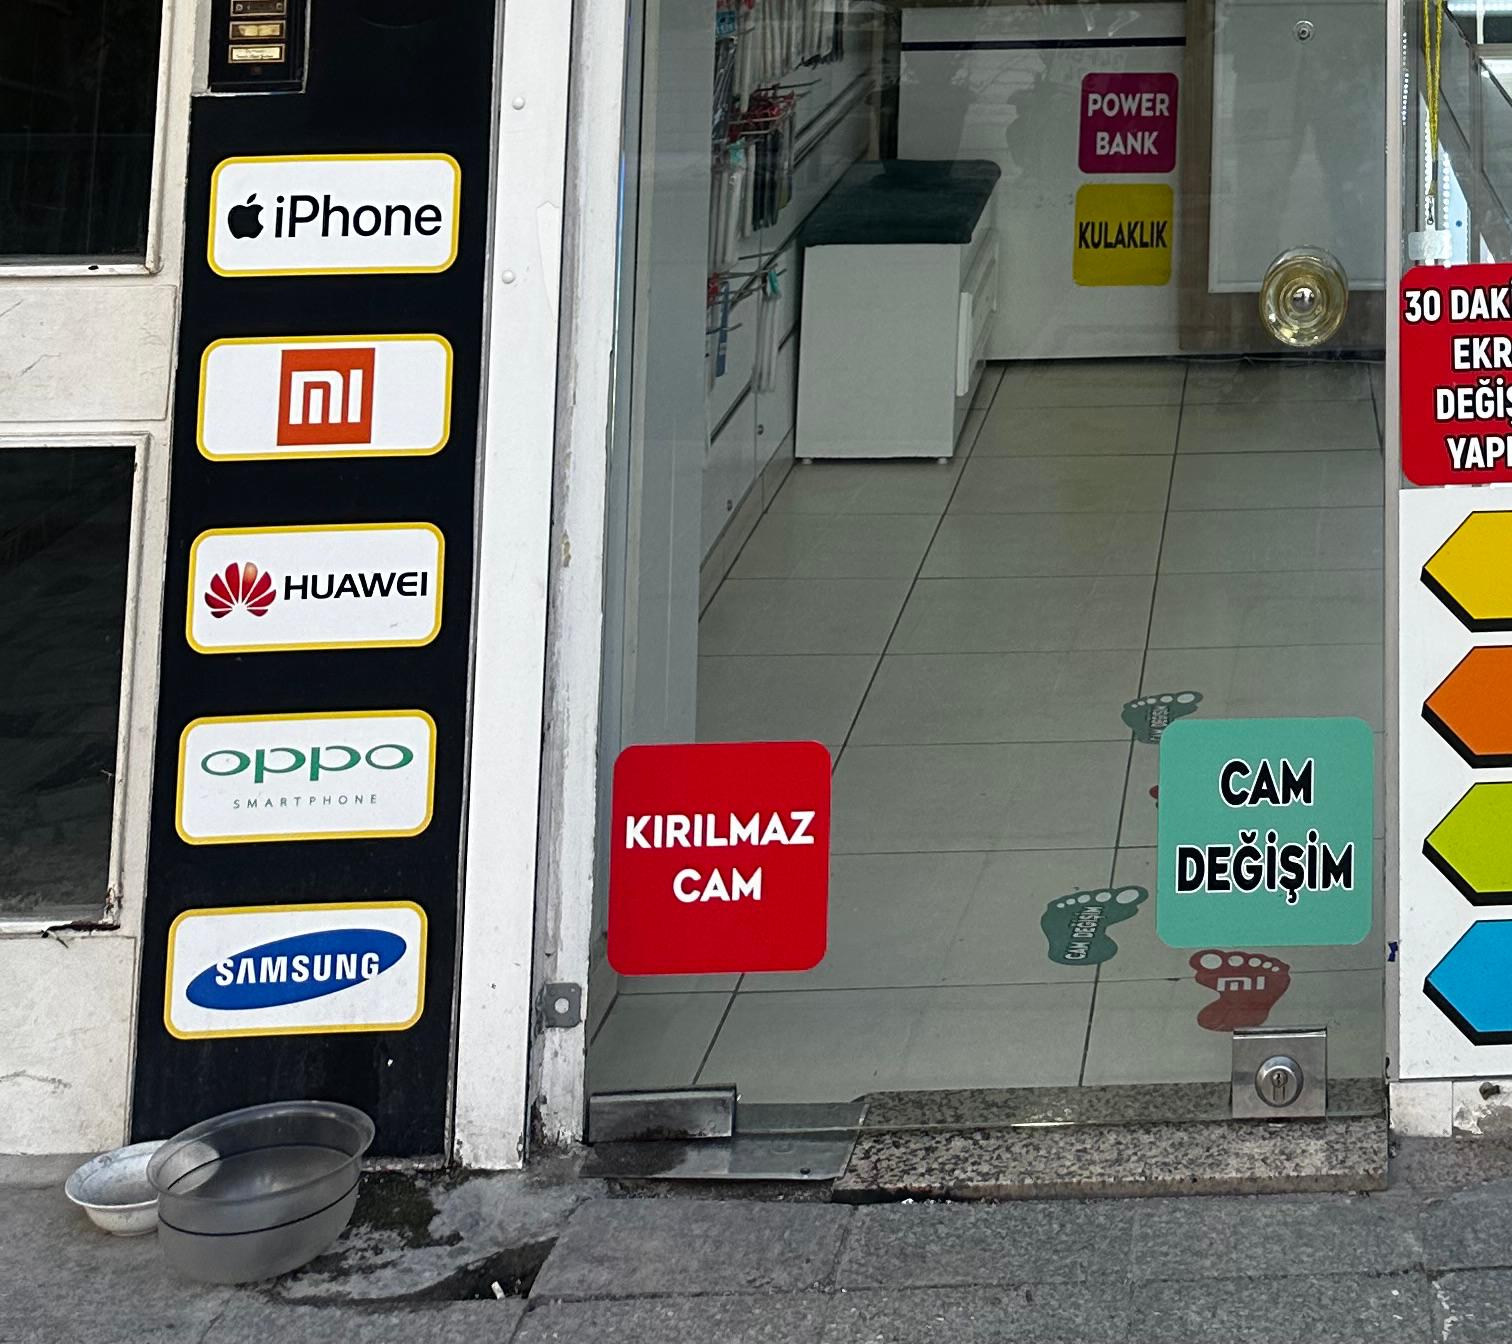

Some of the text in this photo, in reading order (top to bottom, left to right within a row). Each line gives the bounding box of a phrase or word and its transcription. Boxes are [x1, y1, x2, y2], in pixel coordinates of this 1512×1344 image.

[1088, 93, 1170, 118] POWER
[1096, 131, 1158, 155] BANK
[274, 194, 442, 238] iPhone
[1078, 220, 1168, 249] KULAKLIK
[1405, 289, 1441, 322] 30
[284, 570, 428, 601] HUAWEI
[1218, 757, 1314, 808] CAM
[232, 793, 378, 810] SMARTPHONE
[626, 810, 816, 849] KIRILMAZ
[1175, 829, 1354, 905] DEĞİŞİM
[673, 866, 762, 903] CAM
[215, 952, 380, 988] SAMSUNG
